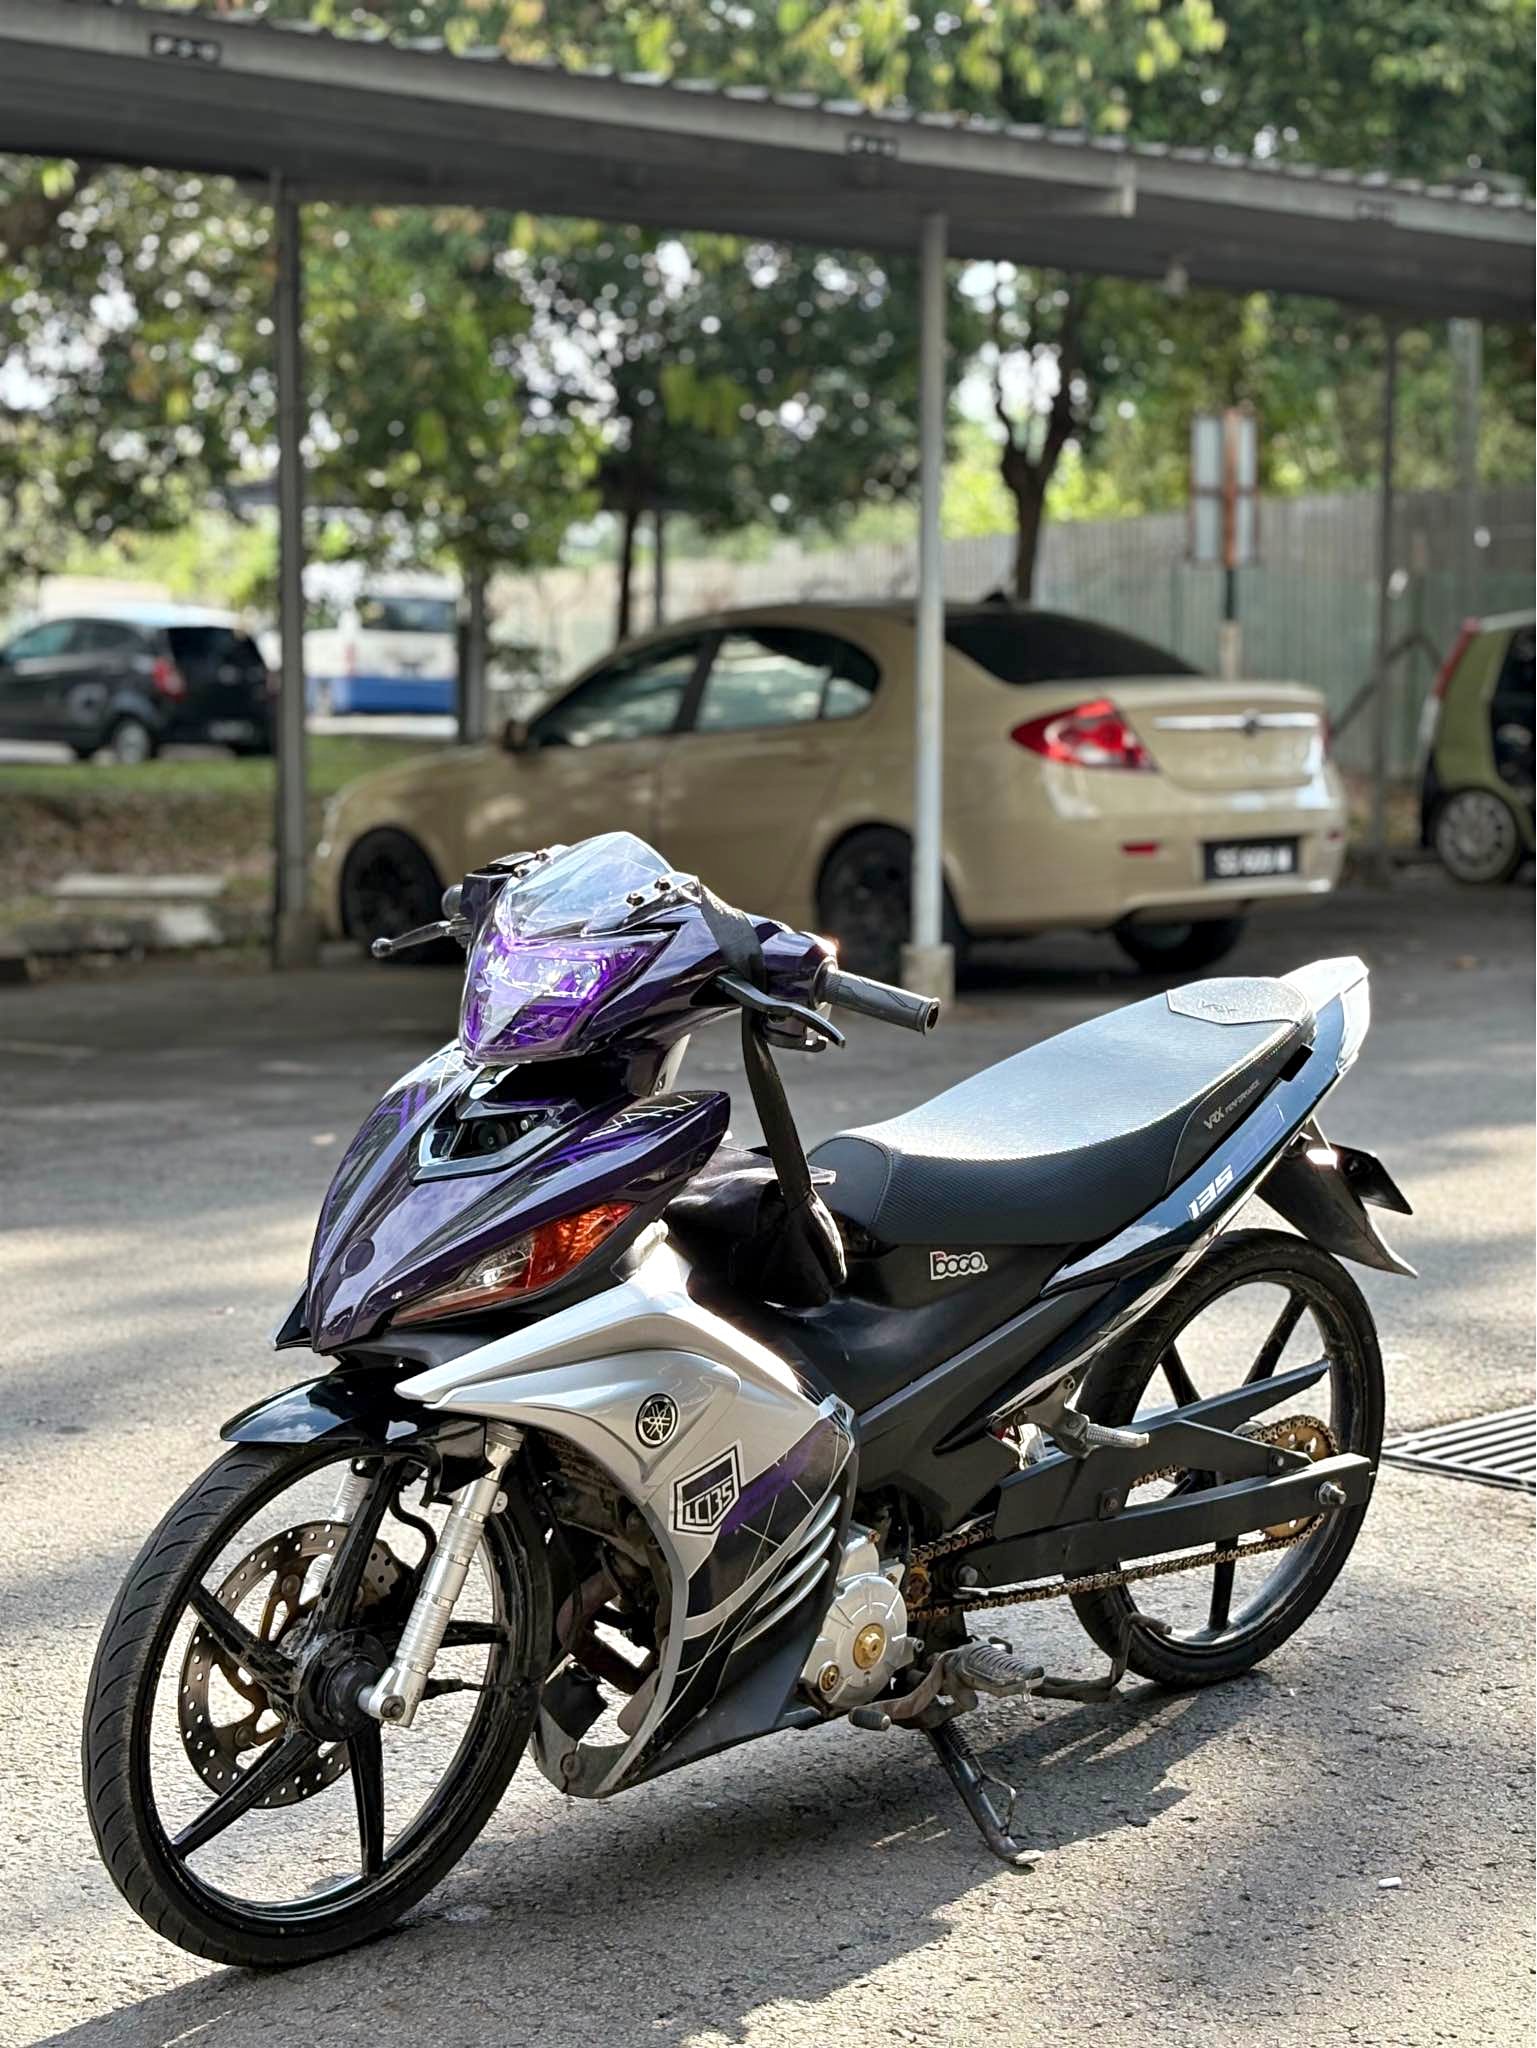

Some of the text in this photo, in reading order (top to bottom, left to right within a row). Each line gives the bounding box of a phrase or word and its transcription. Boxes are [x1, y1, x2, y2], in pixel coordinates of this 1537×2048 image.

[1203, 1106, 1225, 1129] VRX
[1188, 1164, 1234, 1219] 135
[685, 1480, 733, 1524] LC135
